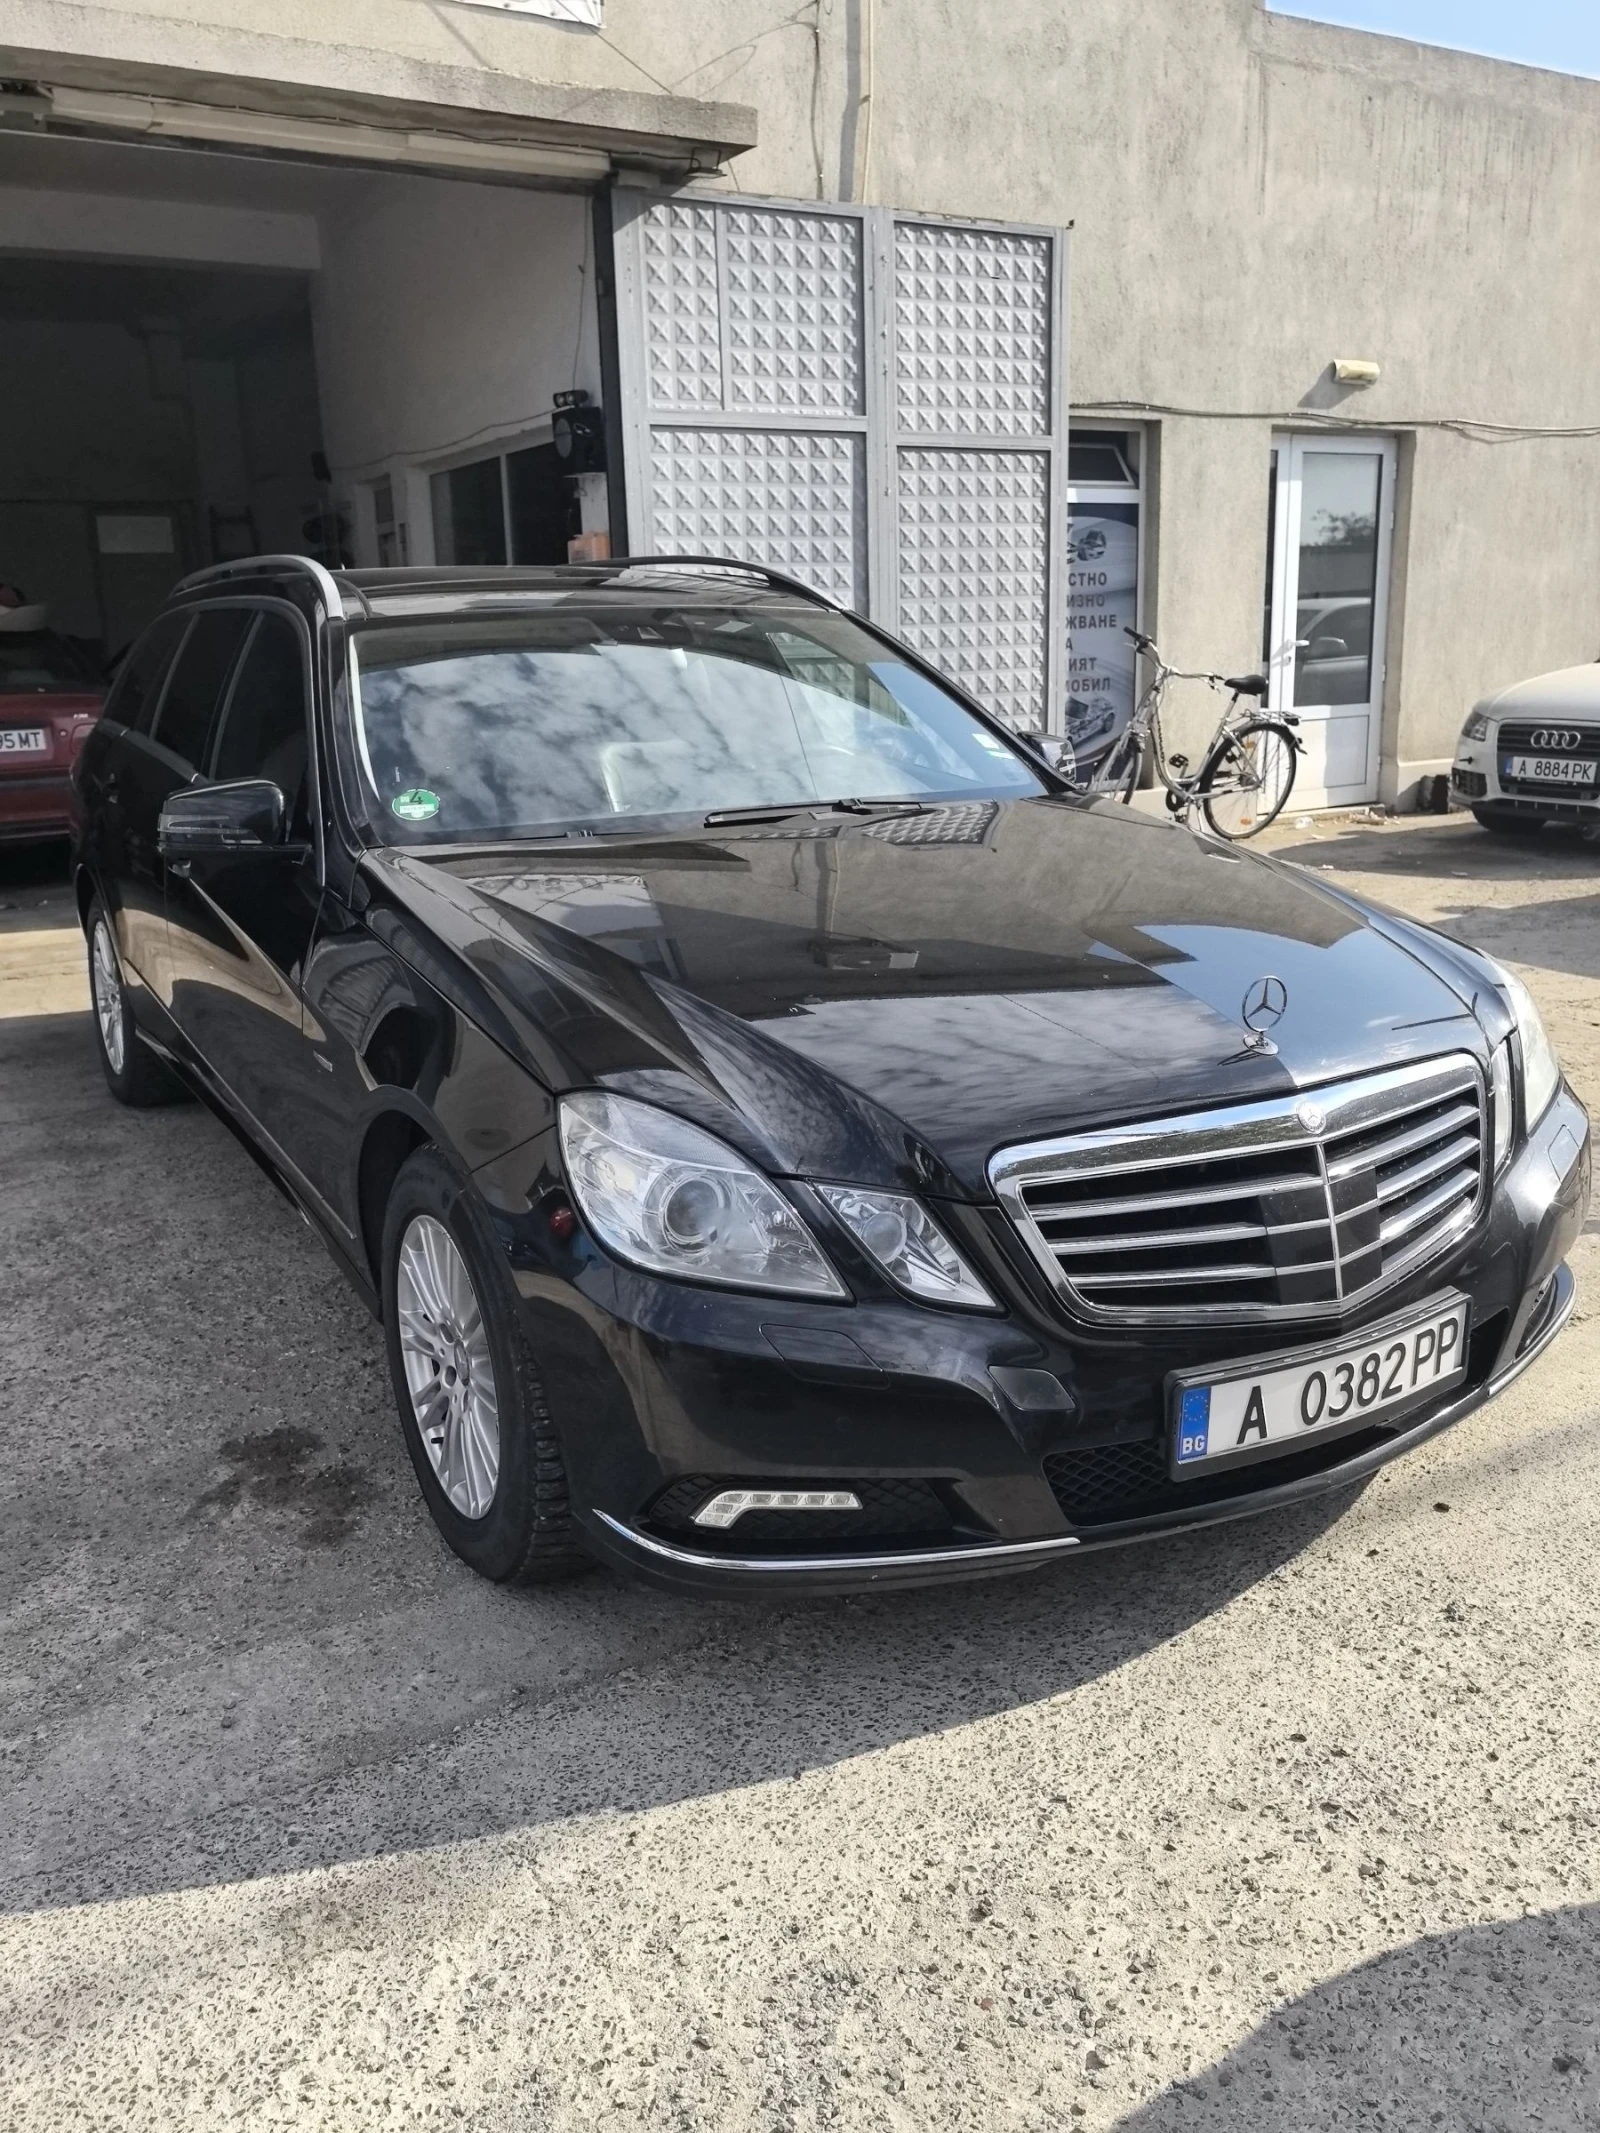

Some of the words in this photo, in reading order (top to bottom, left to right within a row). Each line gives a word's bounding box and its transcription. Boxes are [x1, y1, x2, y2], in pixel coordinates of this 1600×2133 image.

[1518, 759, 1527, 775] A
[1236, 1385, 1268, 1445] A
[1182, 1435, 1206, 1455] BG
